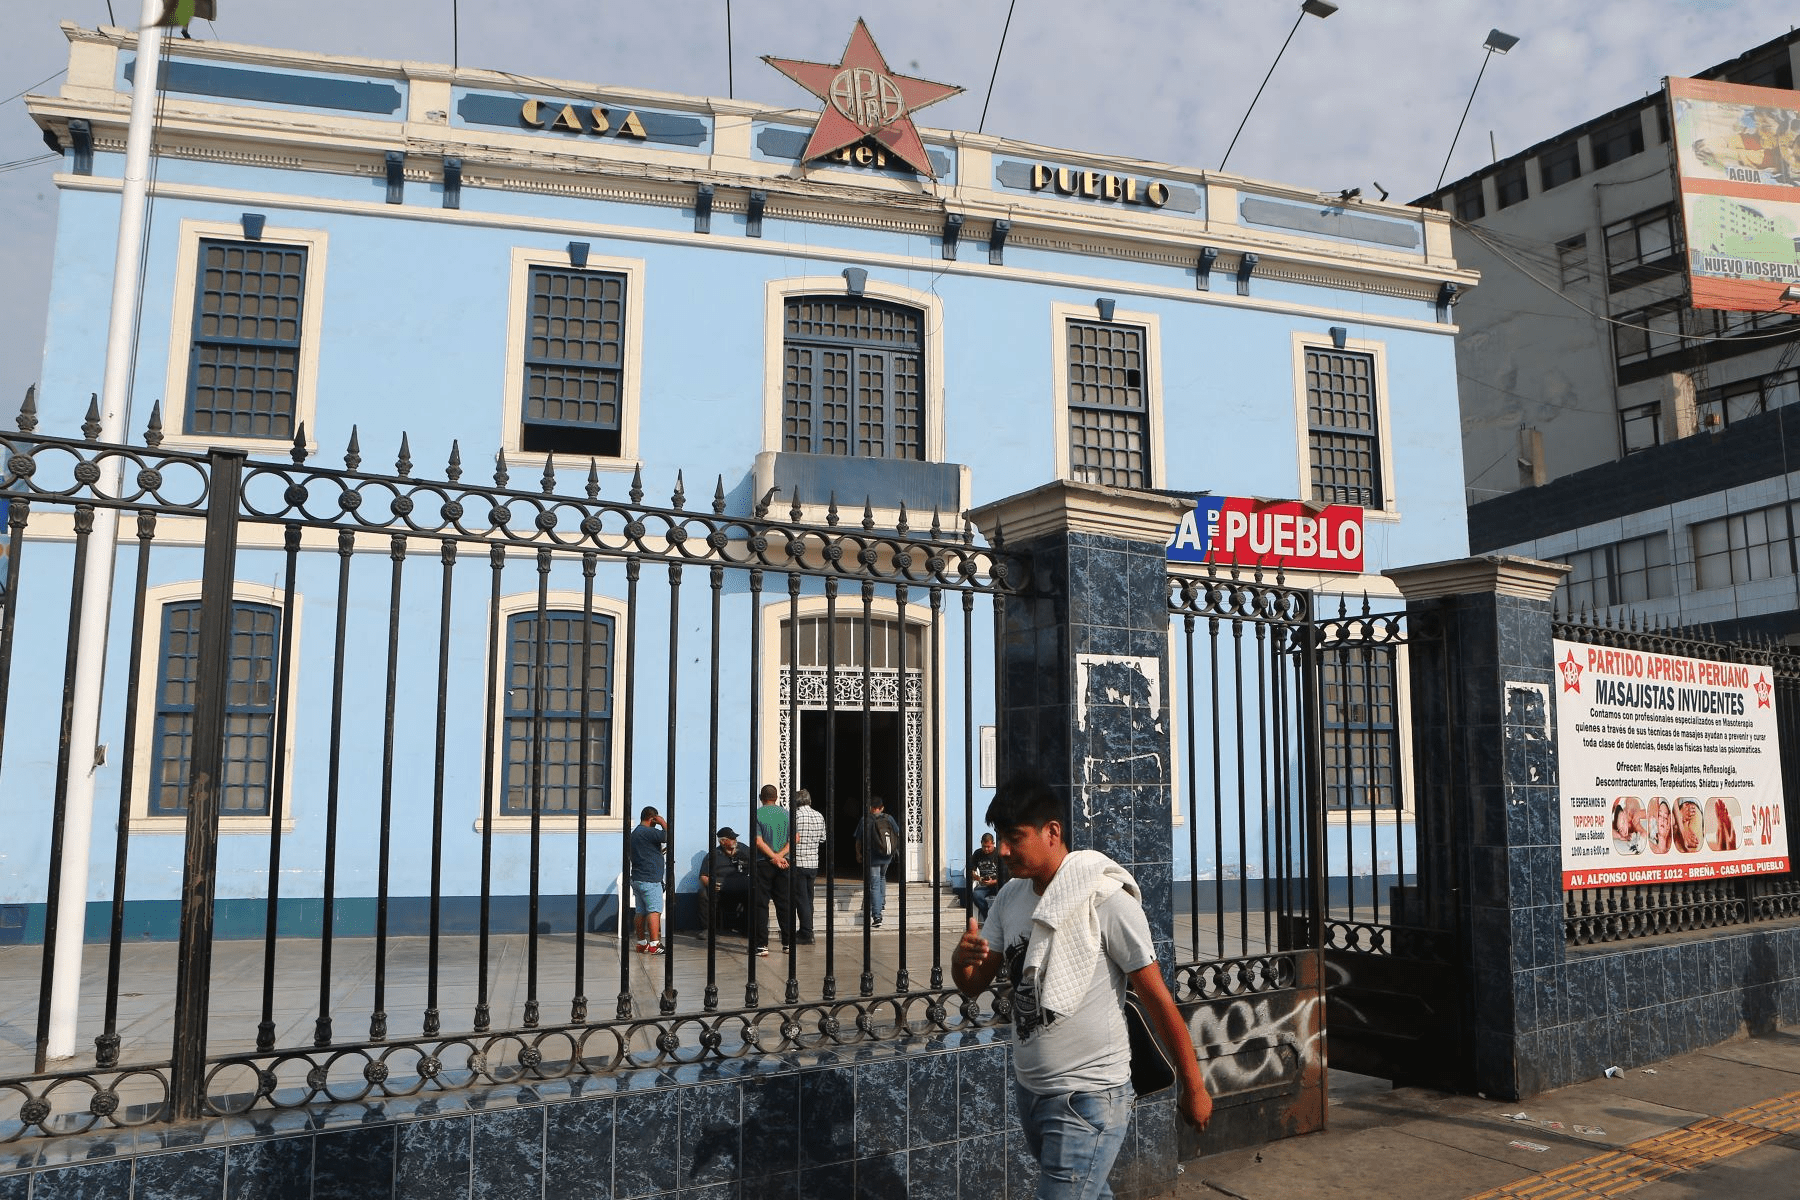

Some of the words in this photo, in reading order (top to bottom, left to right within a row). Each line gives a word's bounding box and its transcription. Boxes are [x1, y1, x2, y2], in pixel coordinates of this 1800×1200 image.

[521, 99, 648, 139] CASA
[1032, 163, 1170, 207] PUEBLO
[1729, 168, 1761, 183] AGUA
[1704, 257, 1743, 274] NUEVO
[1745, 261, 1800, 279] HOSPITAL
[1207, 509, 1220, 551] DEL
[1226, 510, 1362, 560] PUEBLO
[1587, 648, 1644, 679] PARTIDO
[1647, 656, 1696, 684] APRISTA
[1699, 665, 1749, 689] PERUANO
[1595, 679, 1675, 711] MASAJISTAS
[1678, 688, 1745, 716] INVIDENTES
[1590, 708, 1621, 720] Contamos
[1622, 712, 1634, 720] con
[1634, 712, 1674, 724] profesionales
[1674, 716, 1714, 726] especializados
[1722, 718, 1754, 728] Masoterapia
[1575, 722, 1600, 734] quienes
[1602, 725, 1606, 733] a
[1606, 724, 1626, 734] través
[1628, 725, 1635, 734] de
[1636, 728, 1646, 736] sus
[1648, 726, 1672, 737] técnicas
[1673, 728, 1680, 738] de
[1681, 730, 1703, 740] masajes
[1704, 731, 1723, 740] ayudan
[1728, 732, 1748, 742] prevenir
[1582, 737, 1597, 748] toda
[1598, 738, 1615, 748] clase
[1616, 739, 1624, 749] de
[1626, 740, 1656, 752] dolencias,
[1657, 742, 1674, 751] desde
[1675, 743, 1683, 752] las
[1703, 744, 1718, 753] hasta
[1616, 761, 1643, 772] Ofrecen:
[1644, 762, 1669, 774] Masajes
[1670, 763, 1701, 775] Relajantes,
[1595, 776, 1658, 789] Descontracturantes,
[1699, 778, 1719, 788] Shiatzu
[1570, 798, 1575, 808] TE
[1576, 798, 1600, 808] ESPERAMOS
[1570, 874, 1586, 886] AV.
[1587, 872, 1627, 884] ALFONSO
[1629, 870, 1661, 881] UGARTE
[1663, 868, 1683, 879] 1012
[1688, 864, 1715, 878] BREÑA
[1720, 864, 1740, 875] CASA
[1741, 863, 1755, 873] DEL
[1757, 860, 1784, 872] PUEBLO
